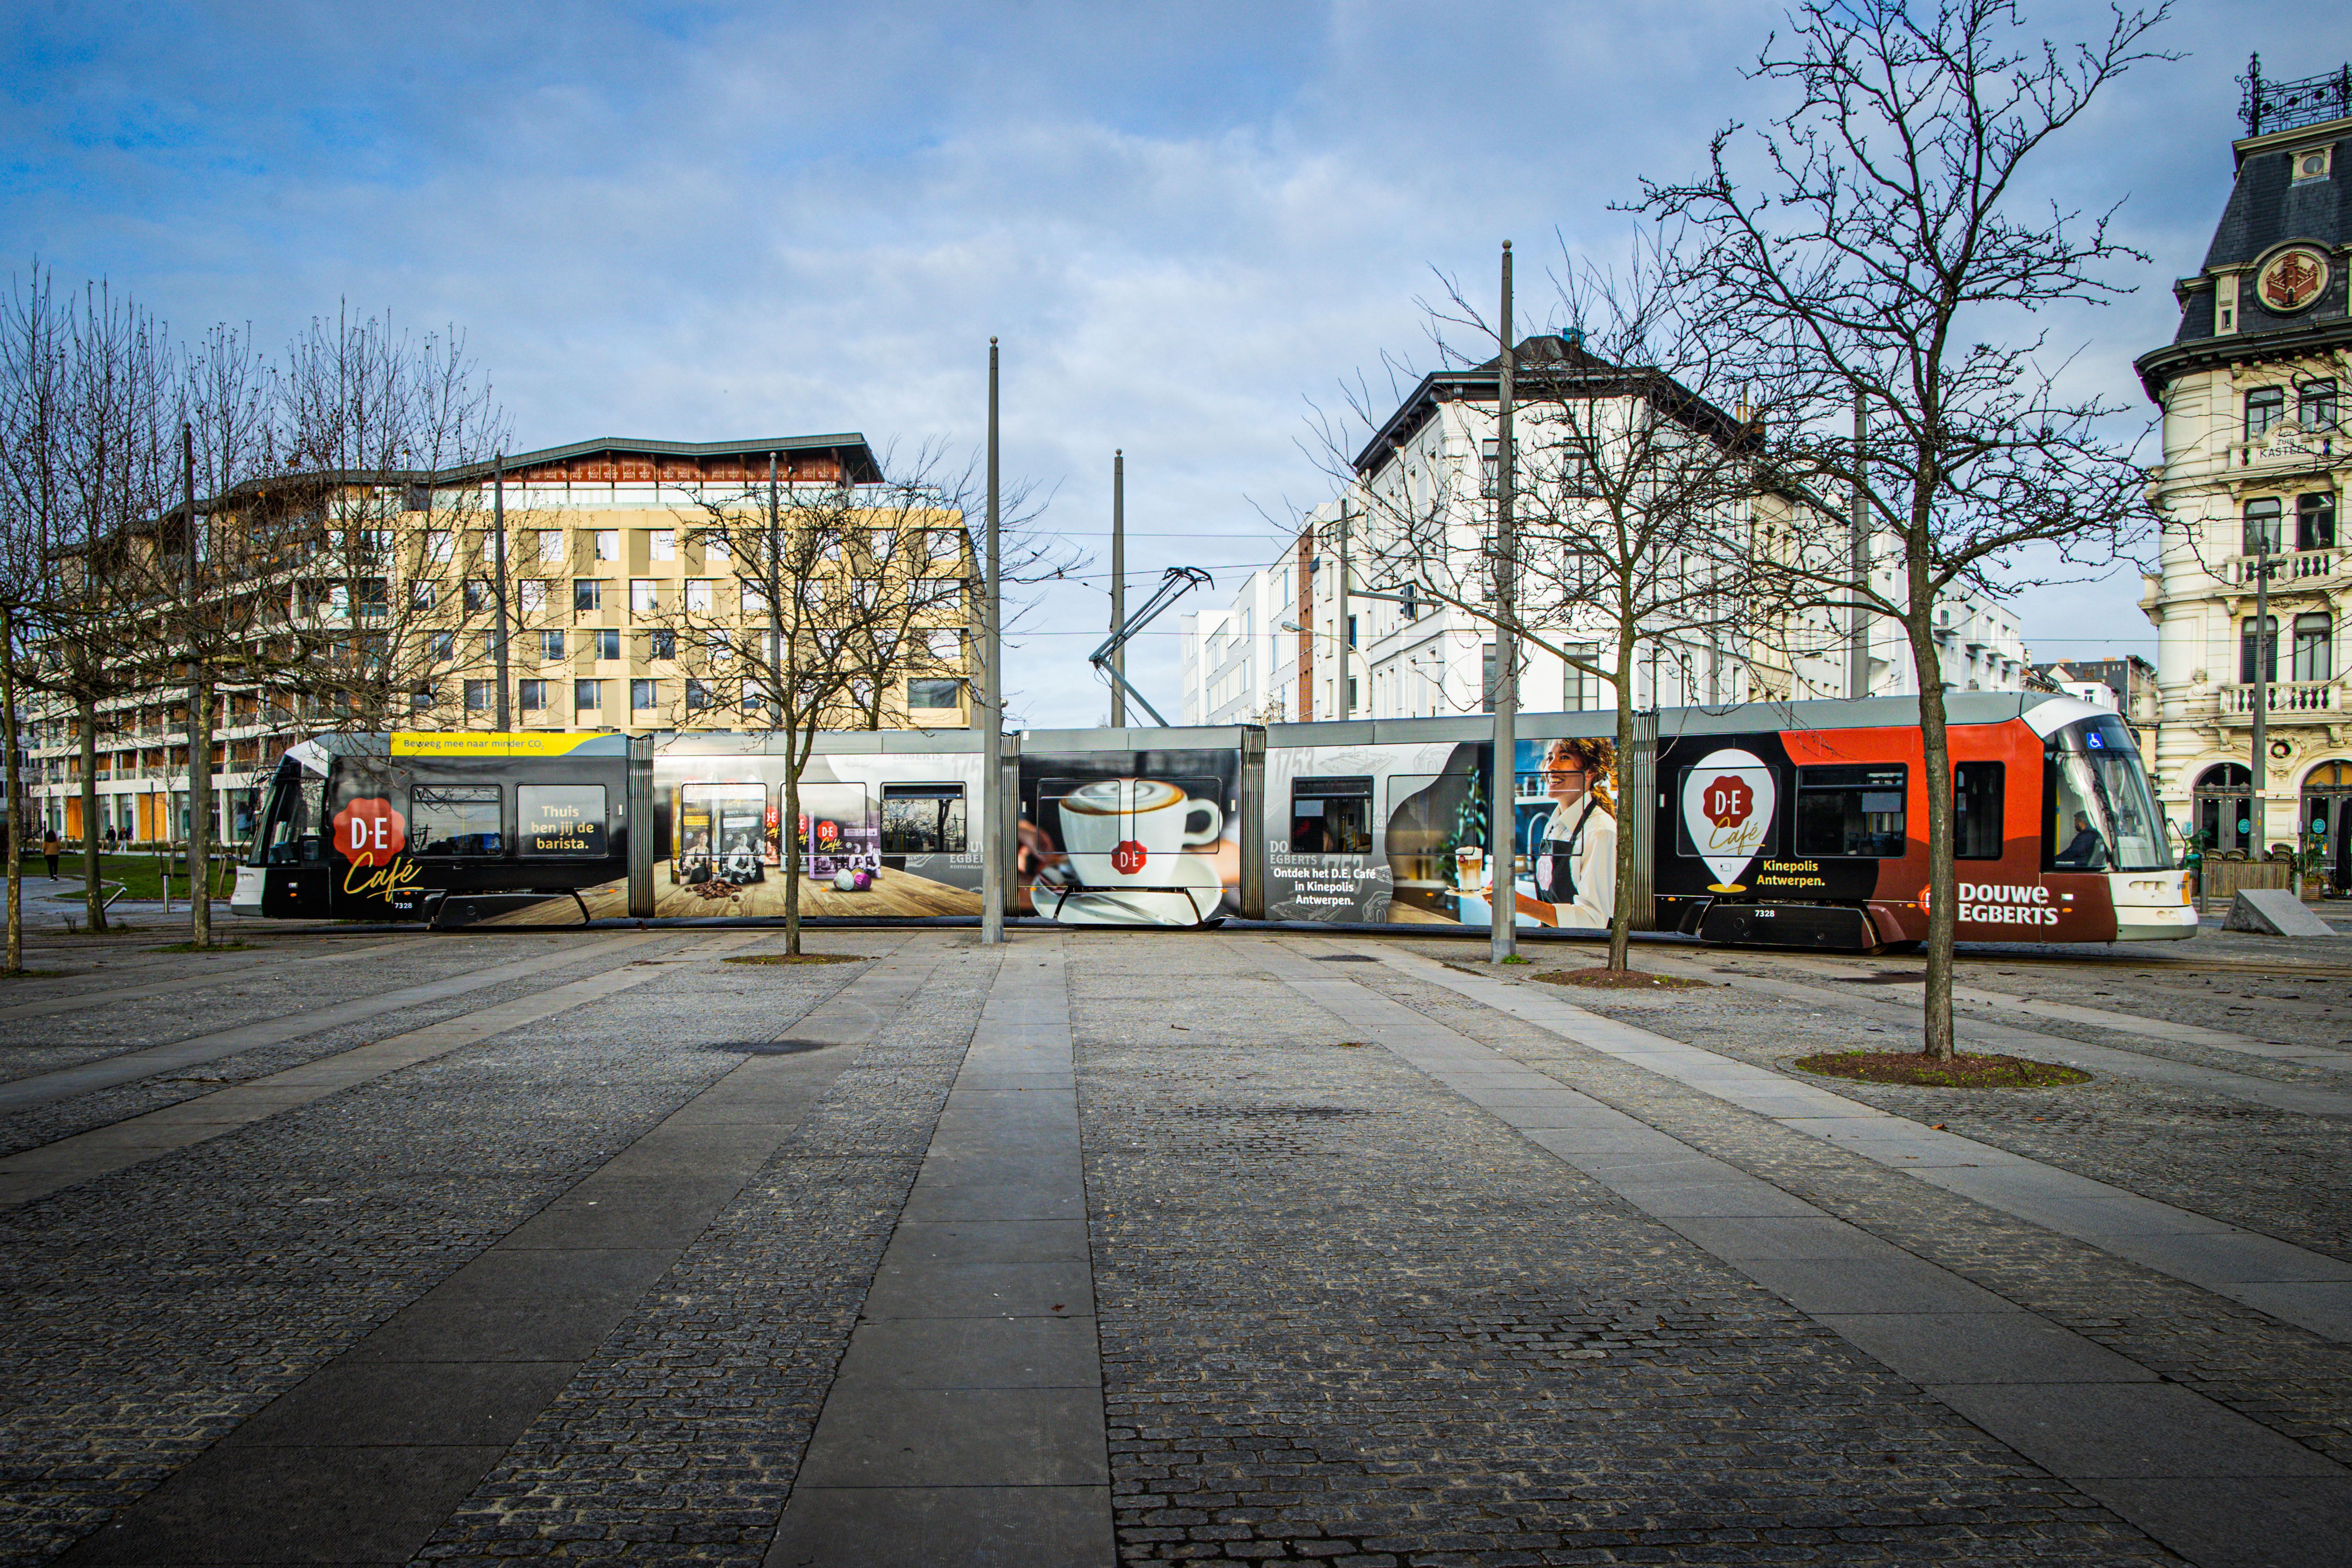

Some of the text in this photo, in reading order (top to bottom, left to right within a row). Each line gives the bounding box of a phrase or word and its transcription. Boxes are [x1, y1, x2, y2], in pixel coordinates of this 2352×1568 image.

[404, 740, 441, 749] Beweeg
[541, 805, 579, 817] Thuis
[531, 821, 594, 836] ben jij de
[1709, 817, 1765, 855] Café
[537, 838, 589, 849] barista.
[820, 837, 842, 853] Café
[1270, 855, 1317, 865] EGBERTS
[1764, 860, 1818, 873] Kinepolis
[344, 851, 423, 902] Café
[1274, 867, 1376, 879] Ontdek het D.E. Café
[1295, 881, 1354, 894] in Kinepolis
[1756, 875, 1826, 888] Antwerpen.
[1296, 894, 1354, 907] Antwerpen.
[1958, 903, 2059, 926] EGBERTS
